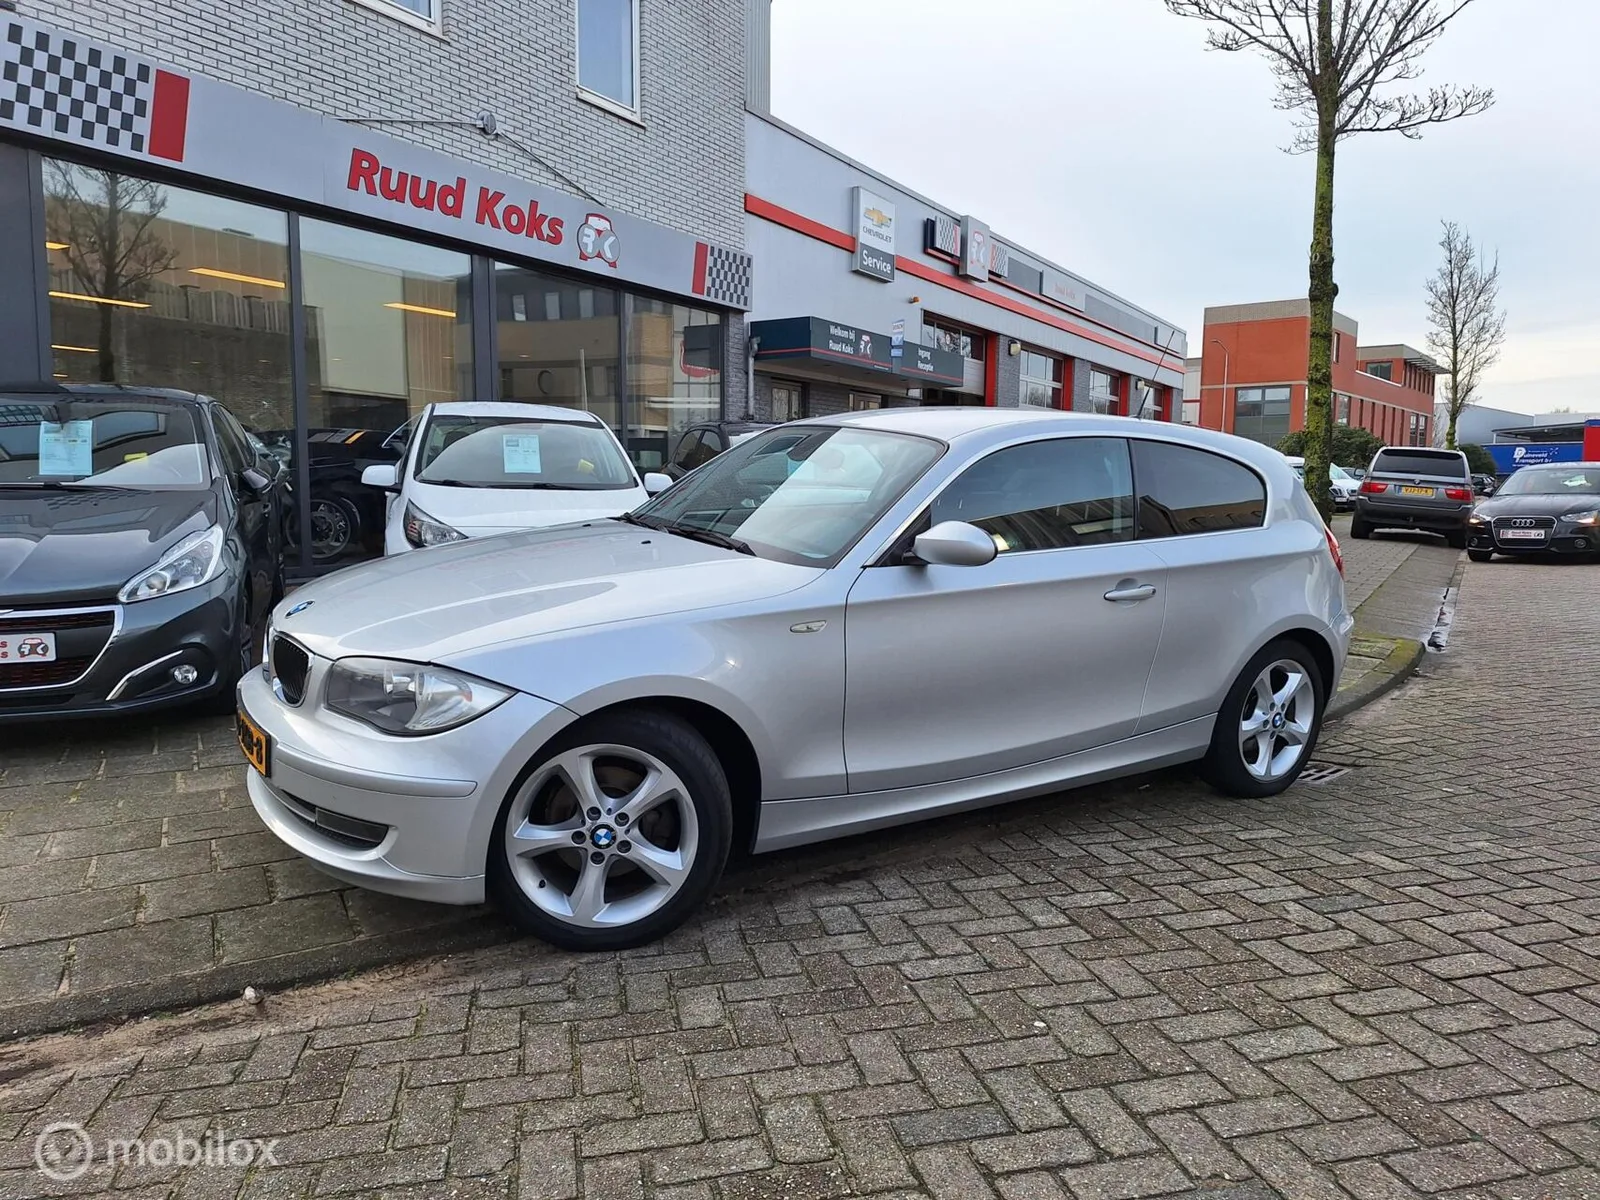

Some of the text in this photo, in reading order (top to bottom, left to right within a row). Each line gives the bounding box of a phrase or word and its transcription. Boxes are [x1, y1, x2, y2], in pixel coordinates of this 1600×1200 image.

[347, 147, 564, 246] Ruud Koks
[862, 226, 892, 243] CHEVROLET
[862, 249, 891, 274] Service
[829, 325, 849, 338] Welkom
[829, 340, 854, 354] Ruud Koks
[918, 348, 931, 360] Ingang
[917, 360, 934, 373] Receptie
